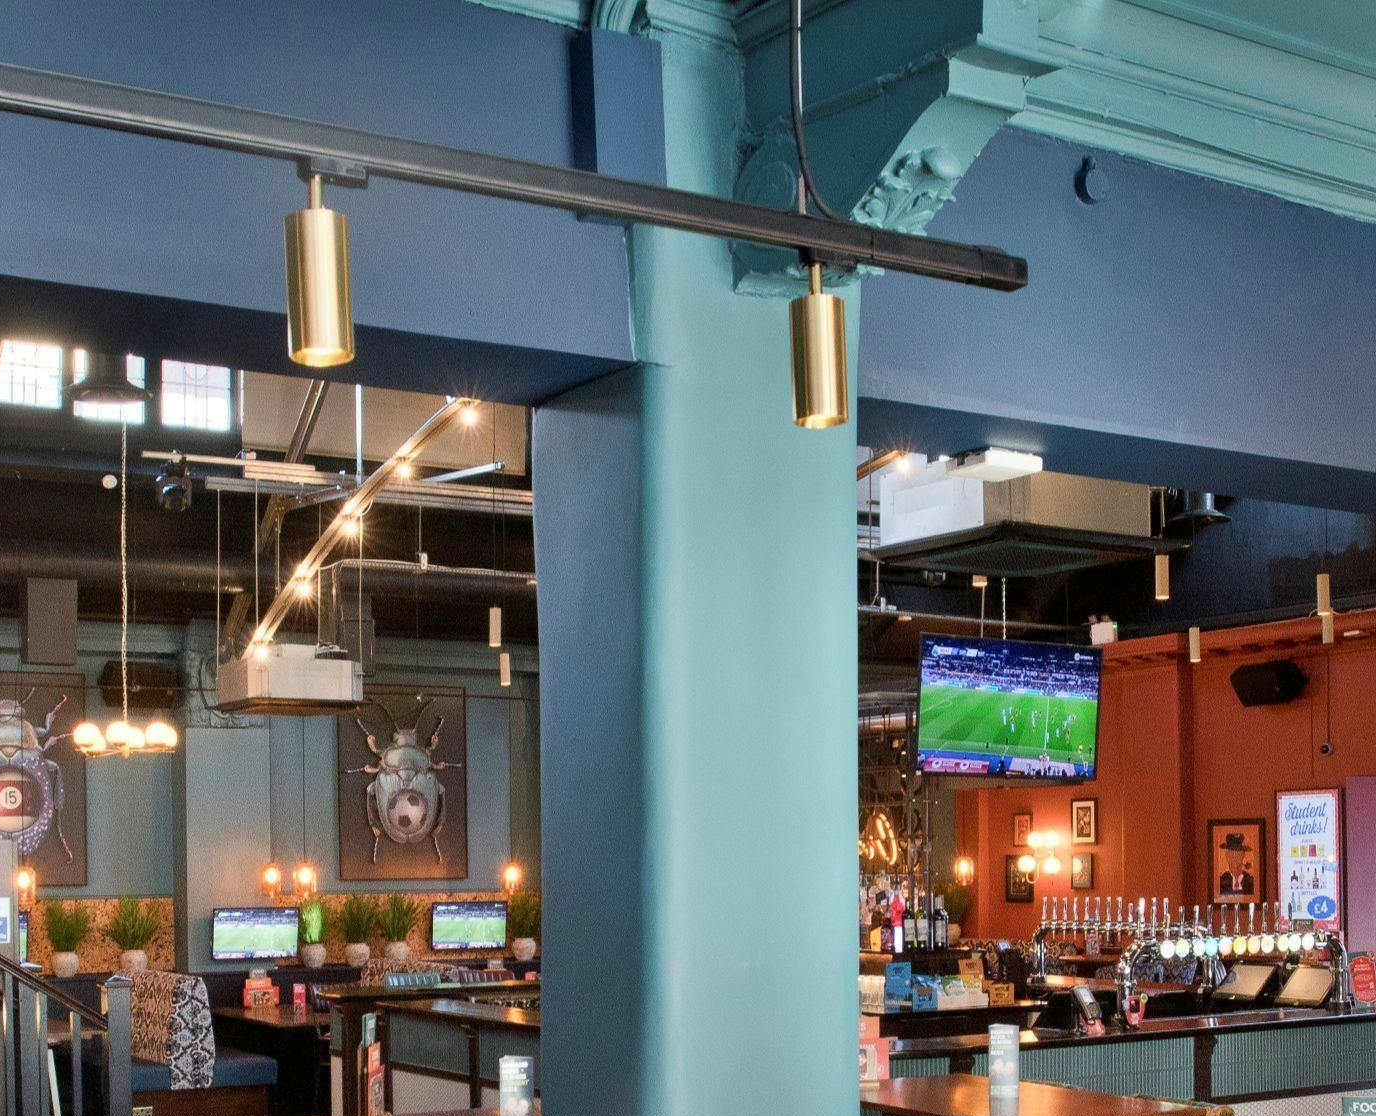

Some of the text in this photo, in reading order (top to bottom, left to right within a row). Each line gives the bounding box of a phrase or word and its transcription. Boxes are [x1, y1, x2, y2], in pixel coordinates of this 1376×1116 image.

[5, 792, 18, 804] 15
[1285, 802, 1326, 820] Student
[1290, 817, 1328, 836] drinks!
[1314, 901, 1329, 913] £4
